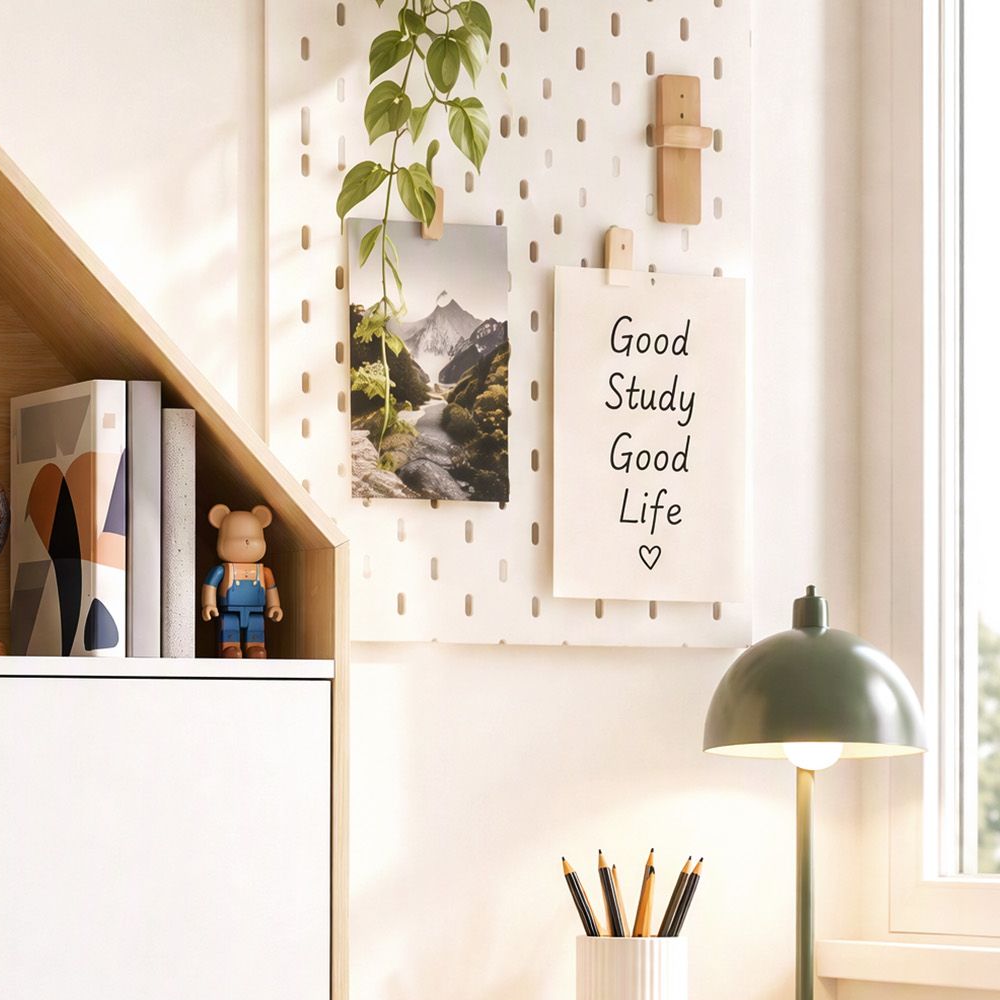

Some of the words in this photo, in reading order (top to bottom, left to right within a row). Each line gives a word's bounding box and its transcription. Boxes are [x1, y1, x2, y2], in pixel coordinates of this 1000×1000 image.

[610, 315, 691, 357] Good
[604, 372, 696, 427] Study
[609, 431, 691, 473] Good
[619, 487, 682, 536] Life
